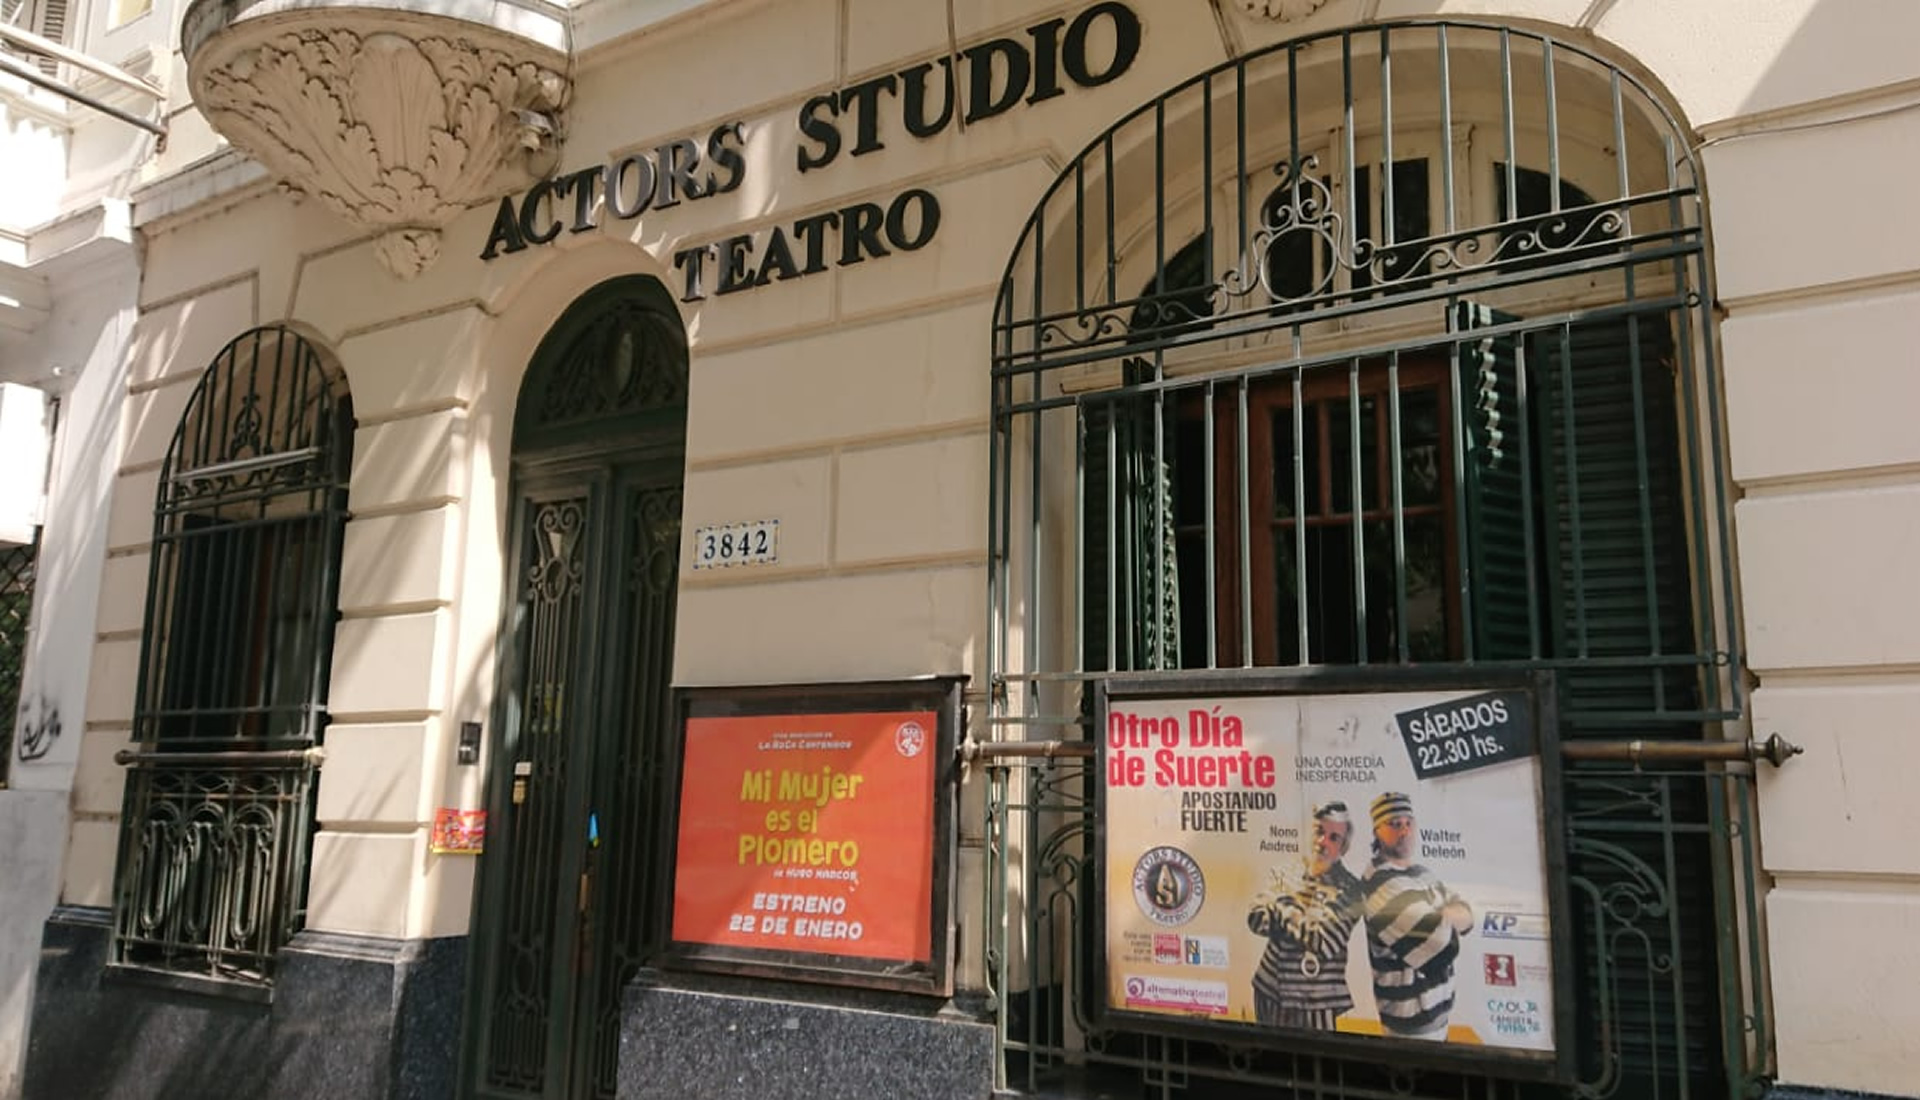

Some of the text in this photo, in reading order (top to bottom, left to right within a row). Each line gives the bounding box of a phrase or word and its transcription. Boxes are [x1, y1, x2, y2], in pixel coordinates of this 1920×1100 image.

[480, 1, 1142, 261] ACTORS STUDIO
[674, 188, 941, 302] TEATRO
[704, 529, 768, 559] 3842
[1109, 705, 1243, 748] Otro Día
[1409, 699, 1508, 743] SÁBADOS
[1295, 755, 1322, 769] UNA
[1418, 734, 1504, 769] 22.30 hs.
[1109, 749, 1275, 788] de Suerte
[1295, 769, 1377, 783] INESPERADA
[741, 766, 864, 807] Mi Mujer
[1181, 791, 1277, 811] APOSTANDO
[765, 809, 818, 833] es el
[1181, 809, 1248, 832] FUERTE
[1269, 825, 1299, 838] Nono
[1260, 839, 1299, 853] Andreu
[1420, 829, 1461, 842] Walter
[738, 834, 860, 867] Plomero
[753, 892, 847, 915] ESTRENO
[729, 914, 863, 941] 22 DE ENERO
[1484, 914, 1517, 931] KP
